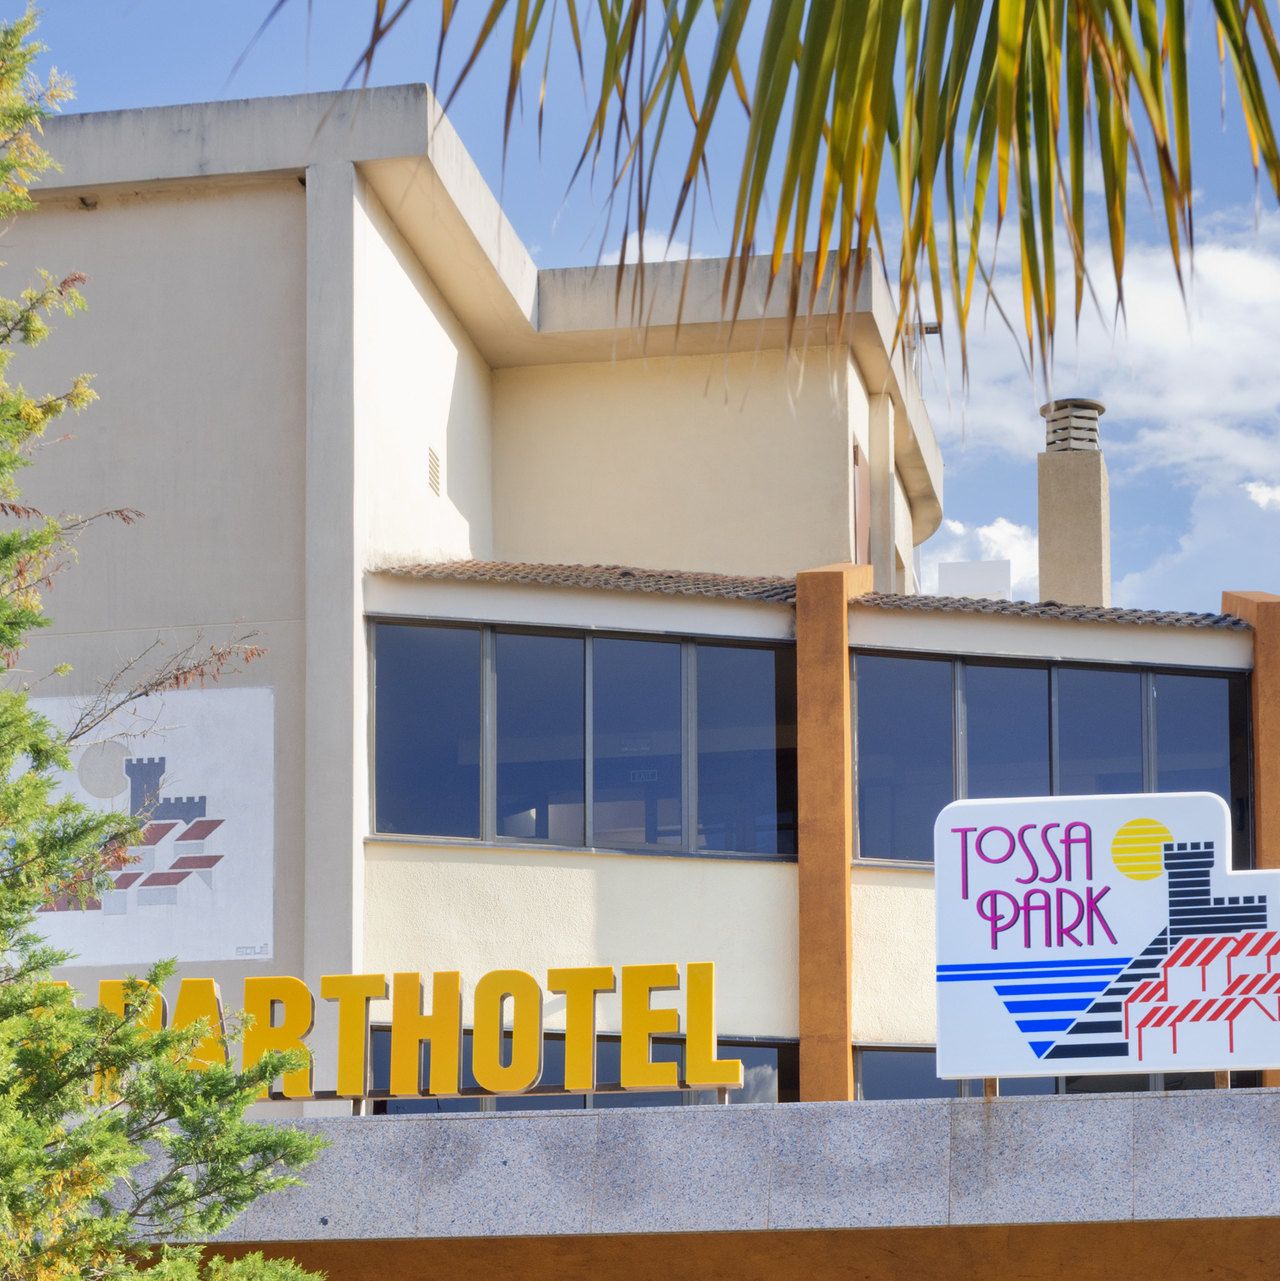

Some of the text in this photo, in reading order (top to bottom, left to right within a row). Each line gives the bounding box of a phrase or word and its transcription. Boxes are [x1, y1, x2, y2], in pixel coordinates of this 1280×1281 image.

[950, 821, 1093, 900] TOSSA
[976, 885, 1118, 950] PARK
[16, 961, 745, 1103] PARTHOTEL
